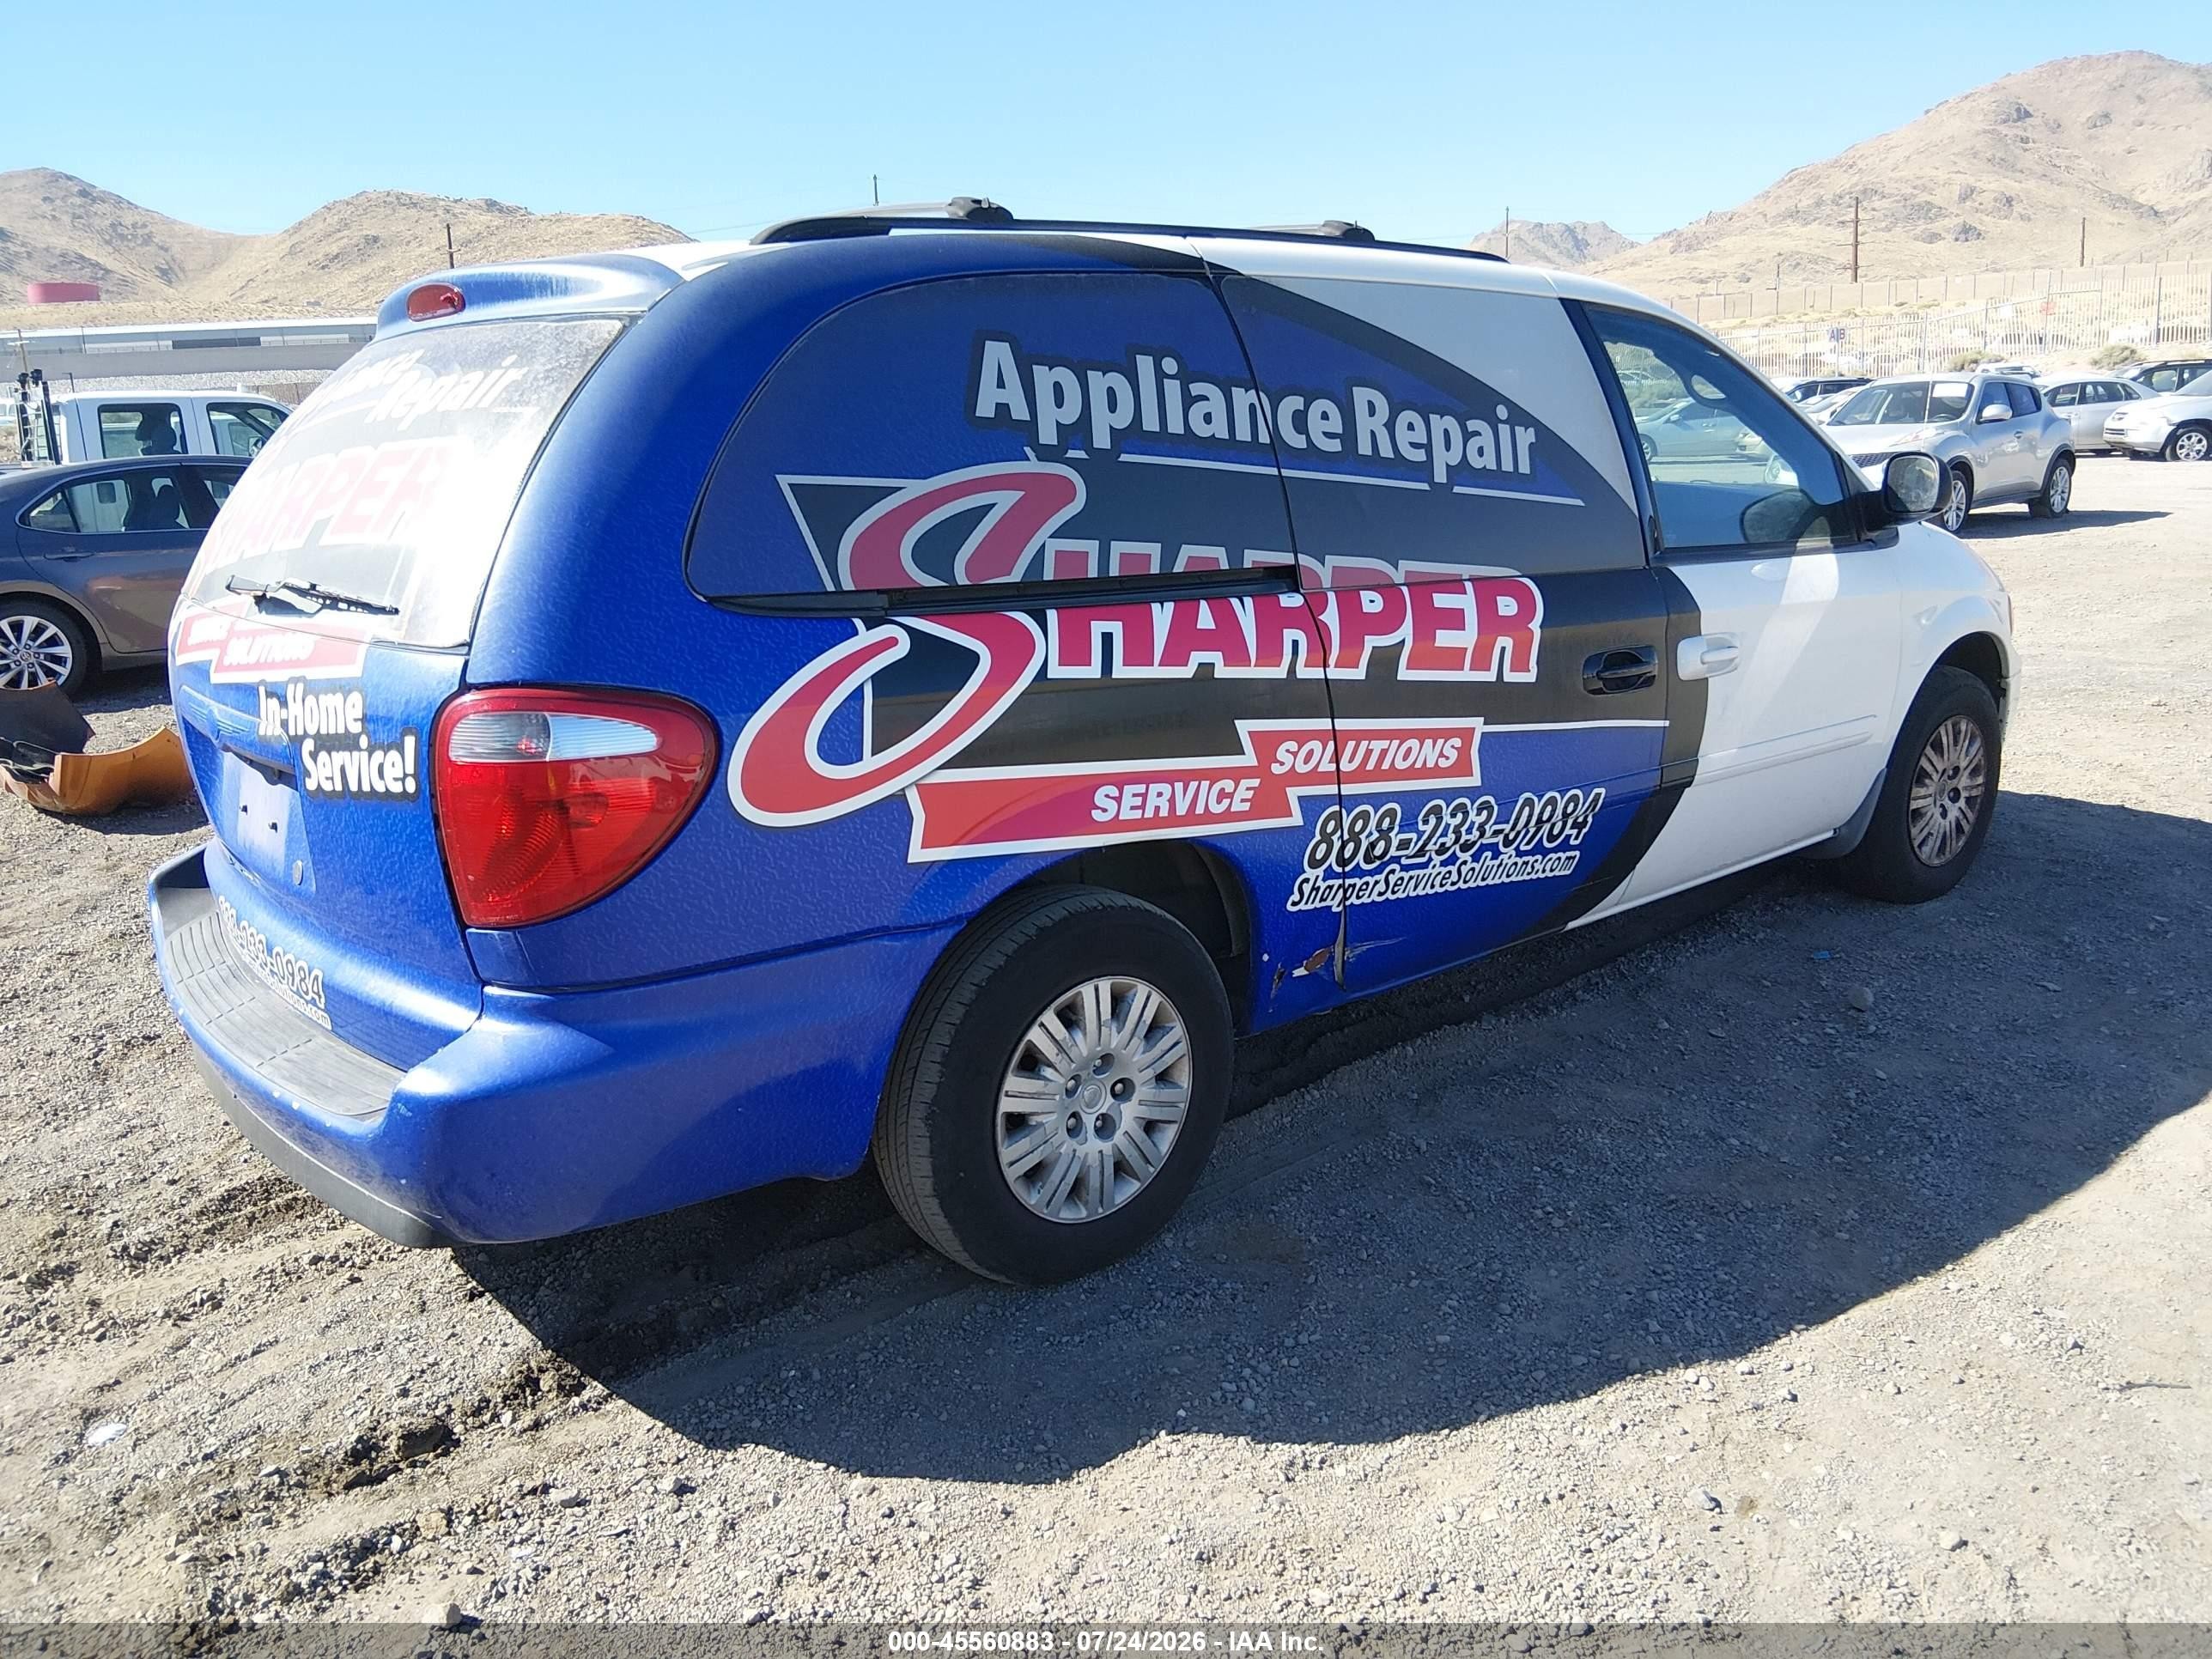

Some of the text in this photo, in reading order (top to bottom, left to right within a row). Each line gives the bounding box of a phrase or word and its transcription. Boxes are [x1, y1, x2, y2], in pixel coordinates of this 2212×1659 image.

[975, 340, 1536, 483] Appliance Repair
[726, 461, 1544, 828] SHARPER
[258, 682, 363, 736] In-Home
[302, 734, 416, 793] Service!
[1270, 738, 1462, 775] SOLUTIONS
[1091, 778, 1261, 823] SERVICE
[1305, 789, 1605, 872] 888-233-0984
[1290, 852, 1578, 910] SharperServiceSolutions.com
